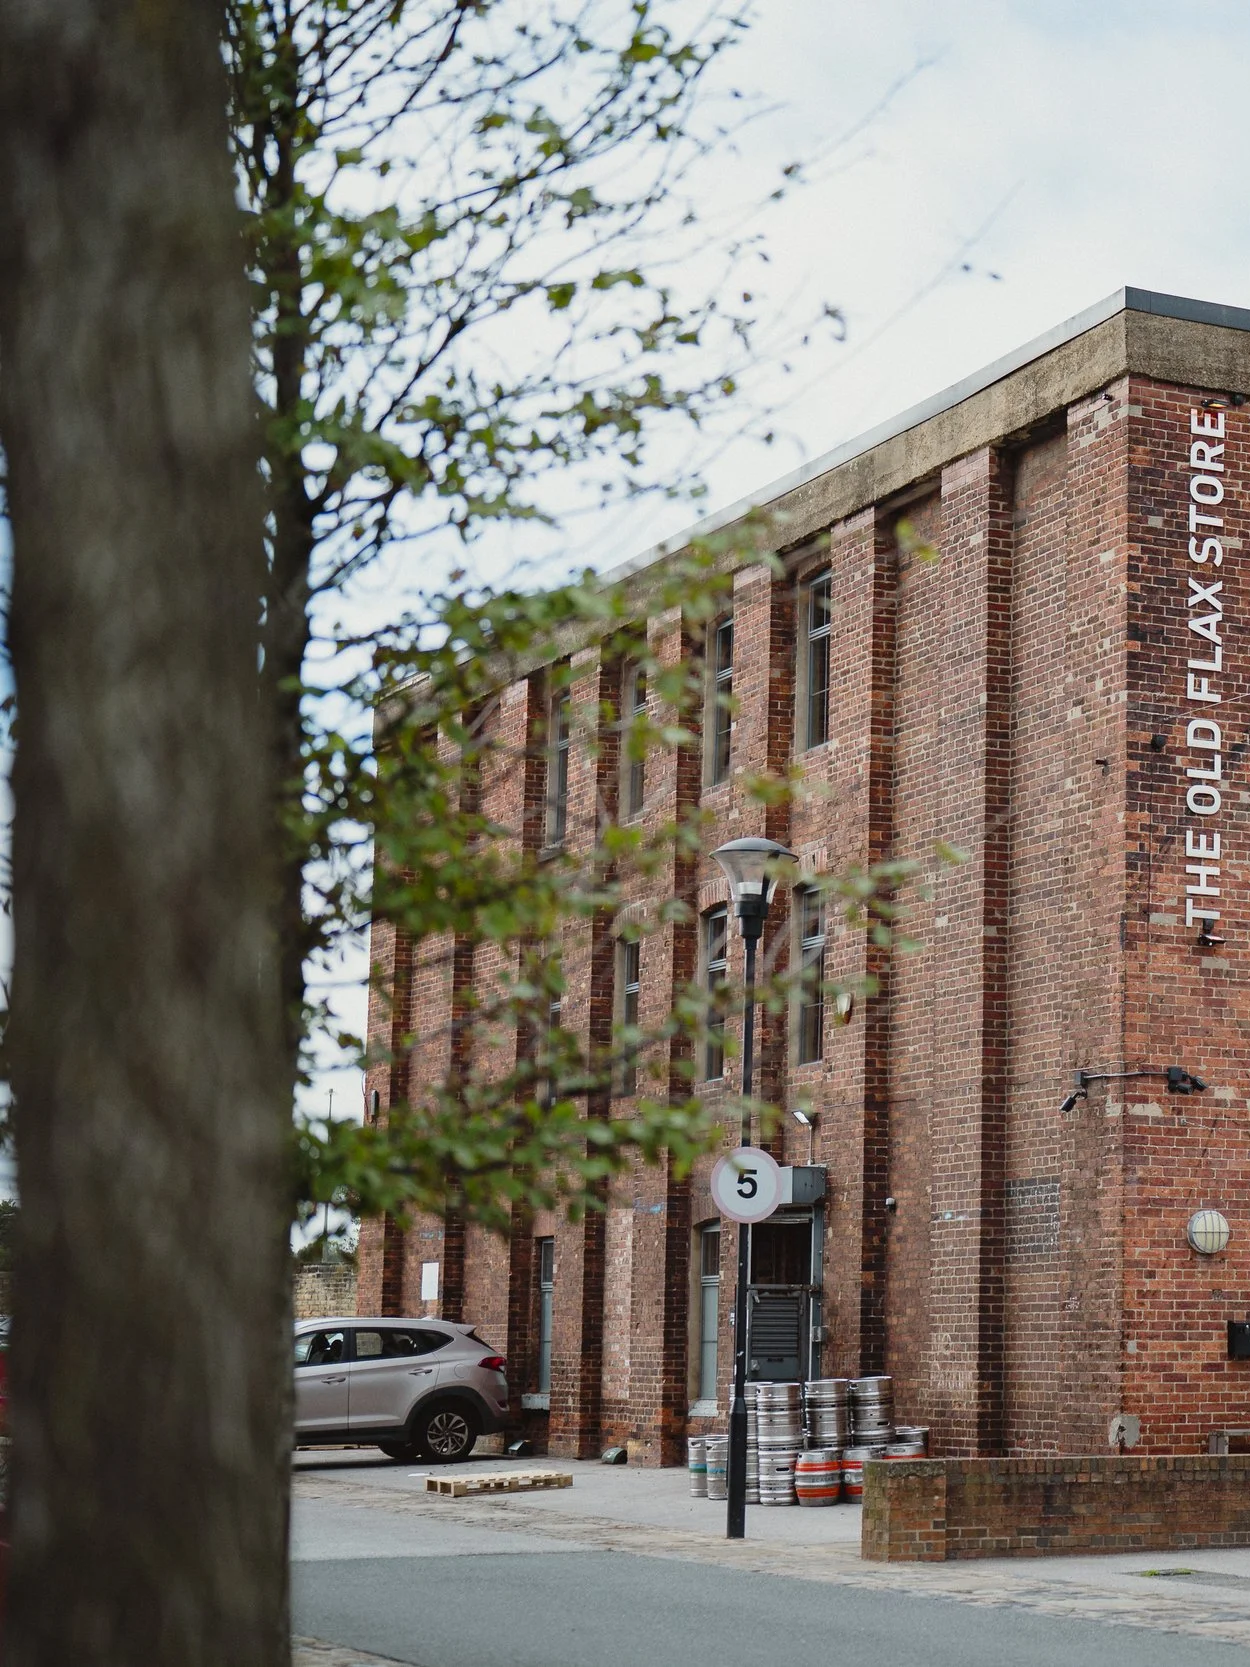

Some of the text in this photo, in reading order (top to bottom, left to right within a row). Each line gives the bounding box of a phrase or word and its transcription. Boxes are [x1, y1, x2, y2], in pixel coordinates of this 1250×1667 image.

[1185, 410, 1226, 928] THE OLD FLAX STORE
[737, 1168, 758, 1199] 5
